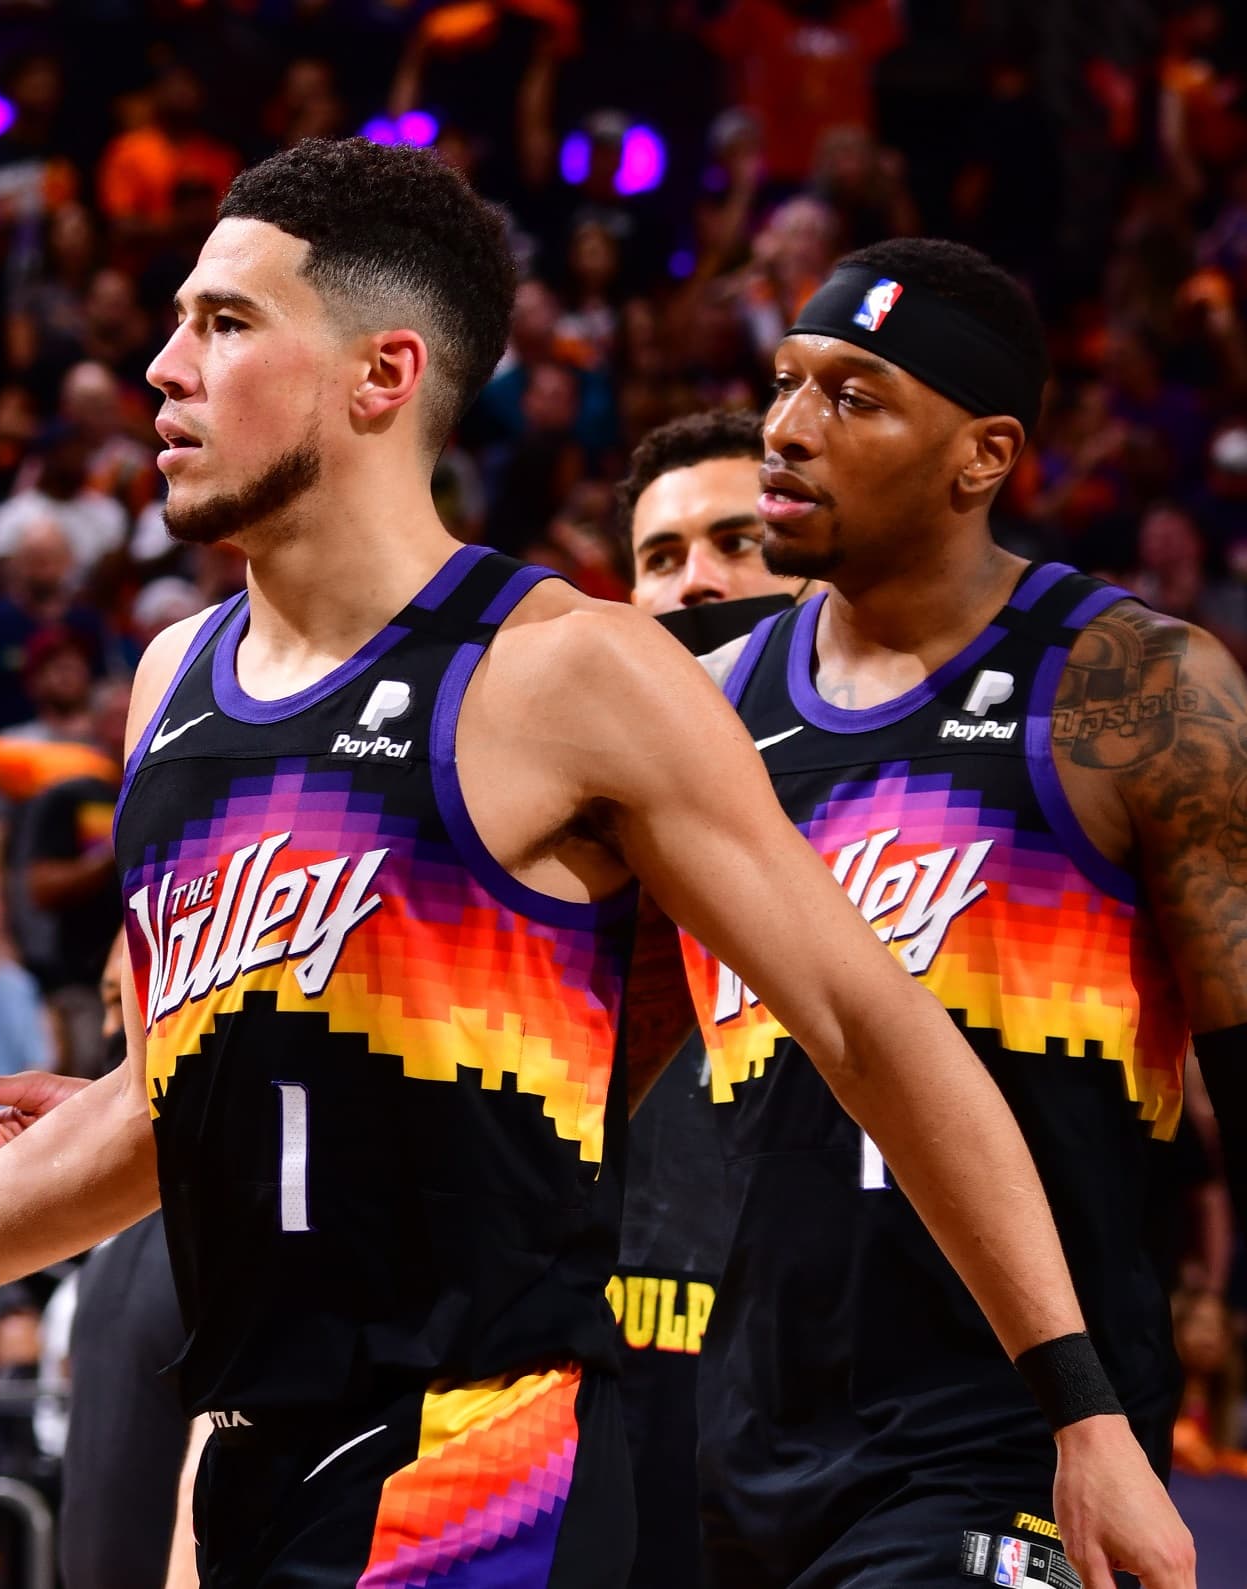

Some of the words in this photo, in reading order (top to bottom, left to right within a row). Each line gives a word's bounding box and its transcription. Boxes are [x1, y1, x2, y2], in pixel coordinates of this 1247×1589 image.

[939, 719, 1018, 741] PayPal
[331, 734, 412, 758] PayPal
[171, 869, 219, 915] THE
[128, 831, 392, 1037] Valley
[275, 1081, 311, 1233] 1
[1015, 1512, 1062, 1540] PHOE
[1032, 1557, 1045, 1569] 50
